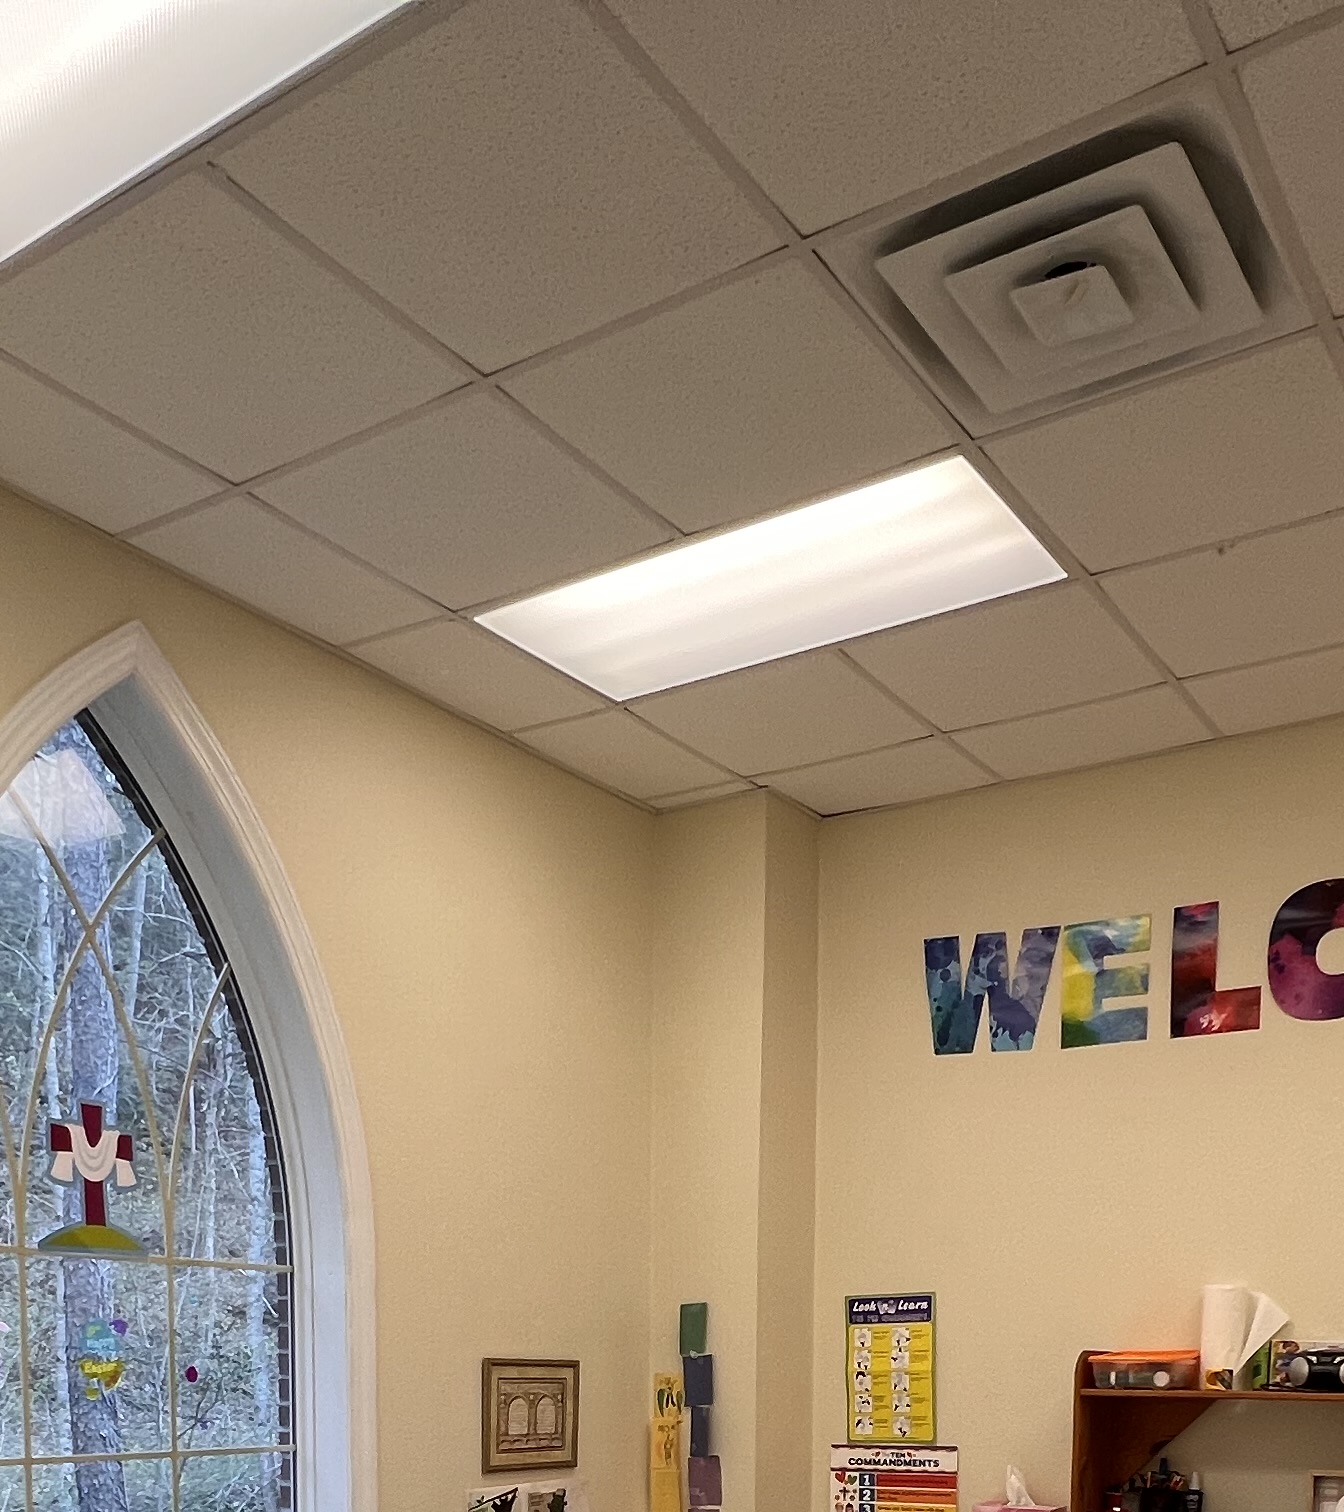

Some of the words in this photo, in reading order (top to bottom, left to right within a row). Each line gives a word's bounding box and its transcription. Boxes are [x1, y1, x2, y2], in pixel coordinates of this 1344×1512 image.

[853, 1301, 876, 1312] Look
[898, 1300, 928, 1310] Learn
[848, 1458, 940, 1467] COMMANDMENTS
[862, 1474, 870, 1485] 1
[862, 1490, 871, 1500] 2
